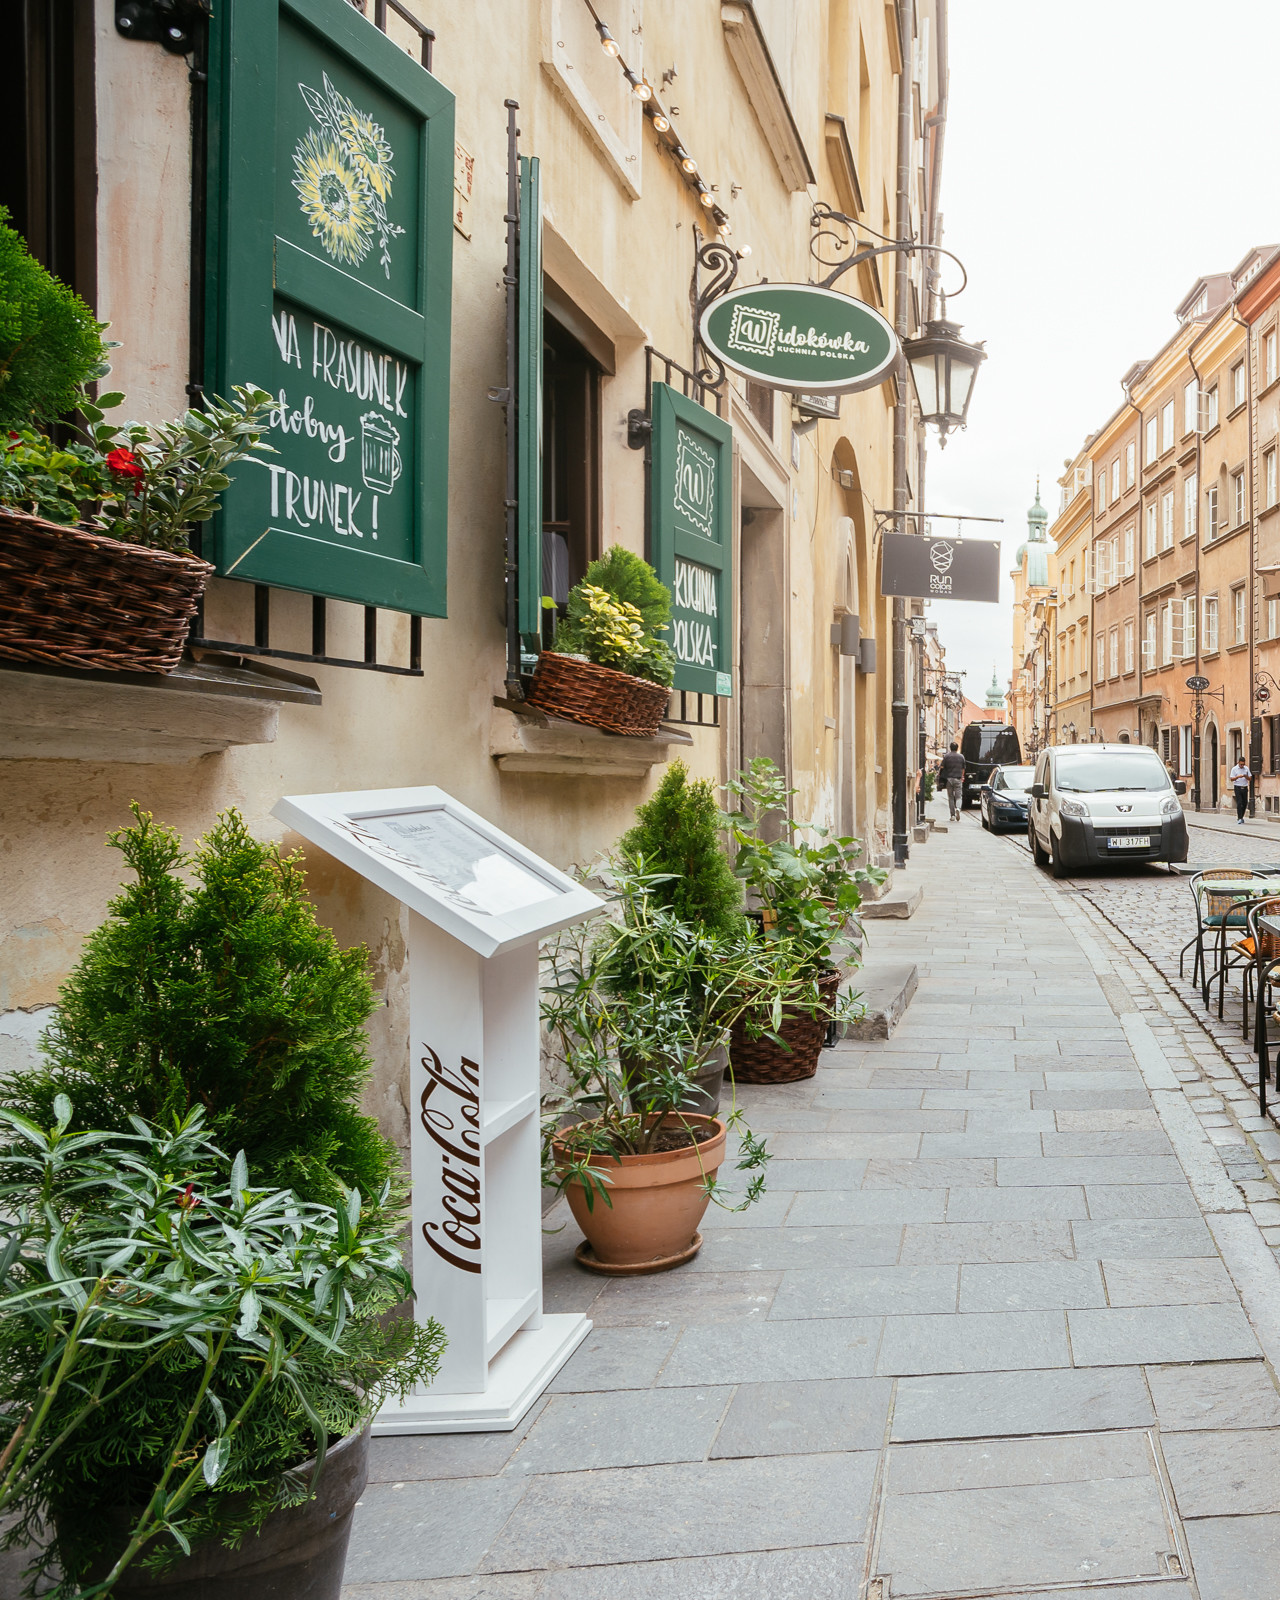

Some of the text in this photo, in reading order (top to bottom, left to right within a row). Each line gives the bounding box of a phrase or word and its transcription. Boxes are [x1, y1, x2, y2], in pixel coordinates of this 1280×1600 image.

[740, 319, 870, 354] Widokówka
[777, 345, 855, 361] KUCHNIA POLSKA
[313, 321, 408, 418] FRASUNEK
[269, 388, 355, 463] dobry
[269, 464, 363, 538] TRUNEK
[1111, 836, 1149, 846] WI 317FH
